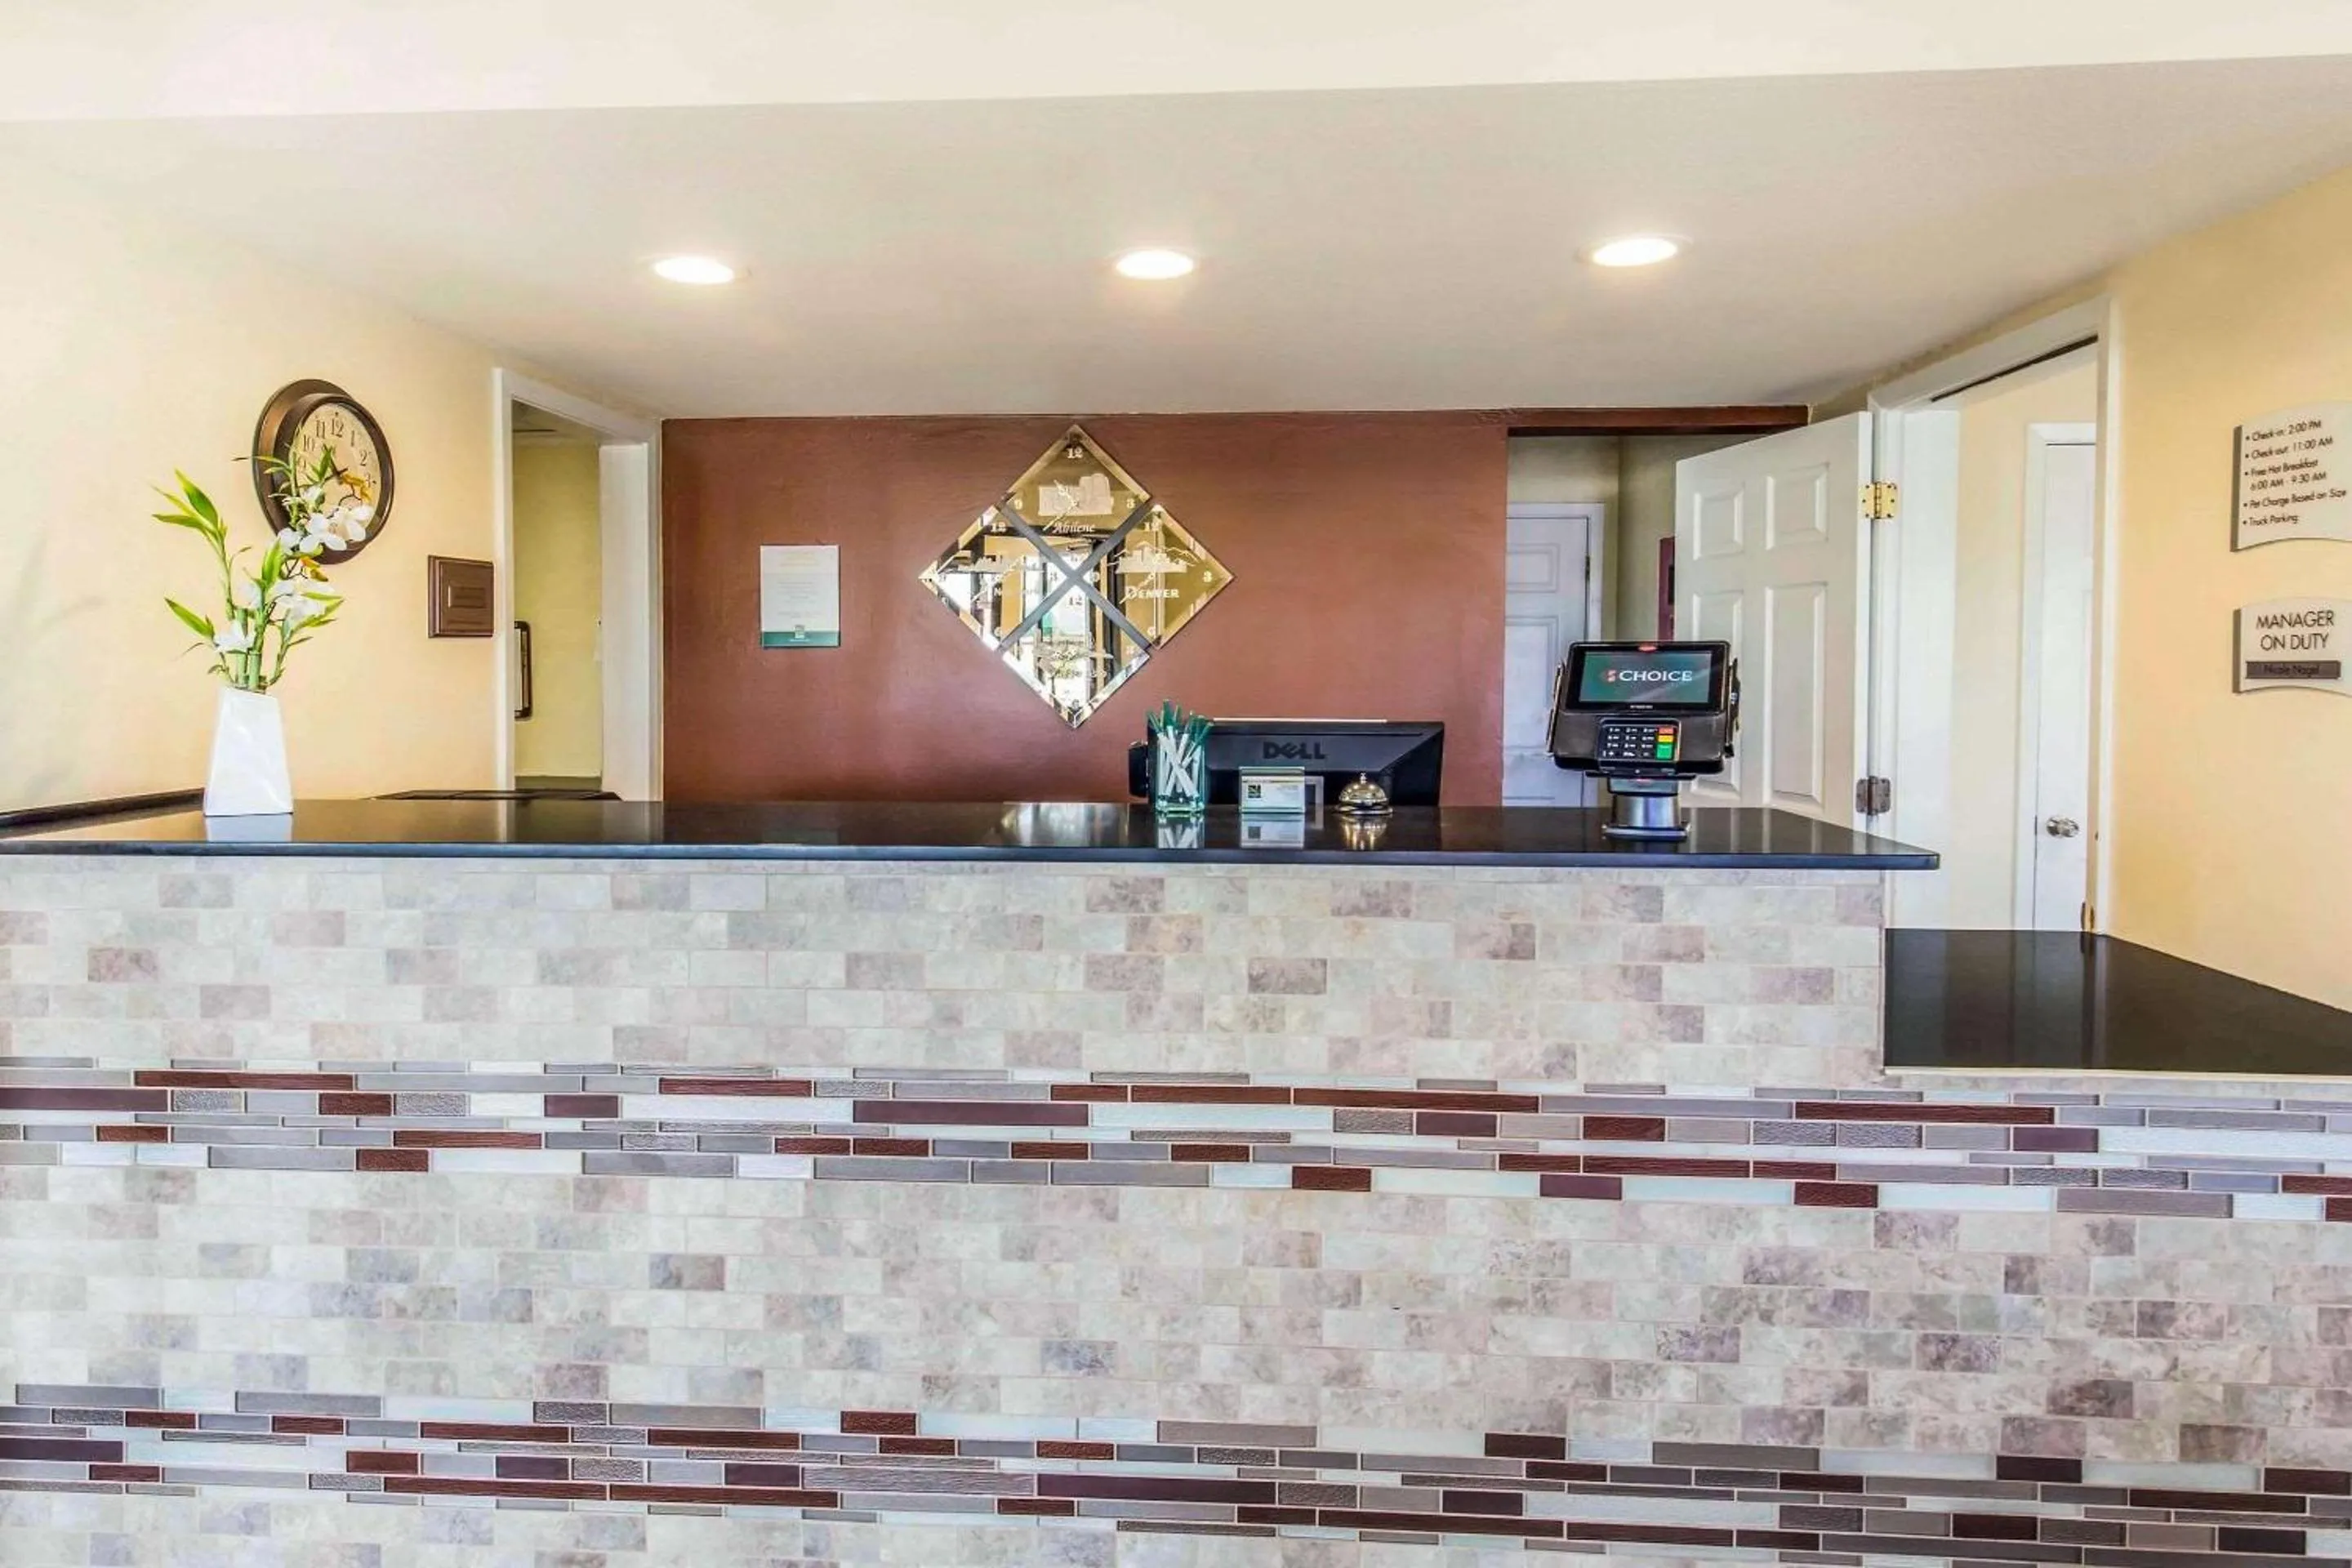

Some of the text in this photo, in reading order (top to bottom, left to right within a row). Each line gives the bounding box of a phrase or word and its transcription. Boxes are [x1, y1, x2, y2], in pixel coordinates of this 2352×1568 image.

[316, 419, 325, 439] 11
[331, 417, 344, 438] 12
[2309, 420, 2321, 430] PM
[303, 434, 315, 452] 10
[350, 430, 355, 447] 1
[2293, 439, 2317, 451] 11:00
[2319, 435, 2333, 446] AM
[360, 450, 368, 466] 2
[1067, 447, 1084, 459] 12
[2251, 458, 2319, 476] Free Hot Breakfast
[2270, 479, 2284, 488] AM
[2312, 470, 2327, 481] AM
[2262, 497, 2290, 508] Charge
[2291, 492, 2314, 502] Based
[2329, 488, 2346, 497] Size
[2249, 514, 2299, 526] Truck Parking
[2256, 610, 2335, 630] MANAGER
[2260, 633, 2329, 651] ON DUTY
[1619, 670, 1693, 682] CHOICE
[1263, 742, 1327, 760] DELL
